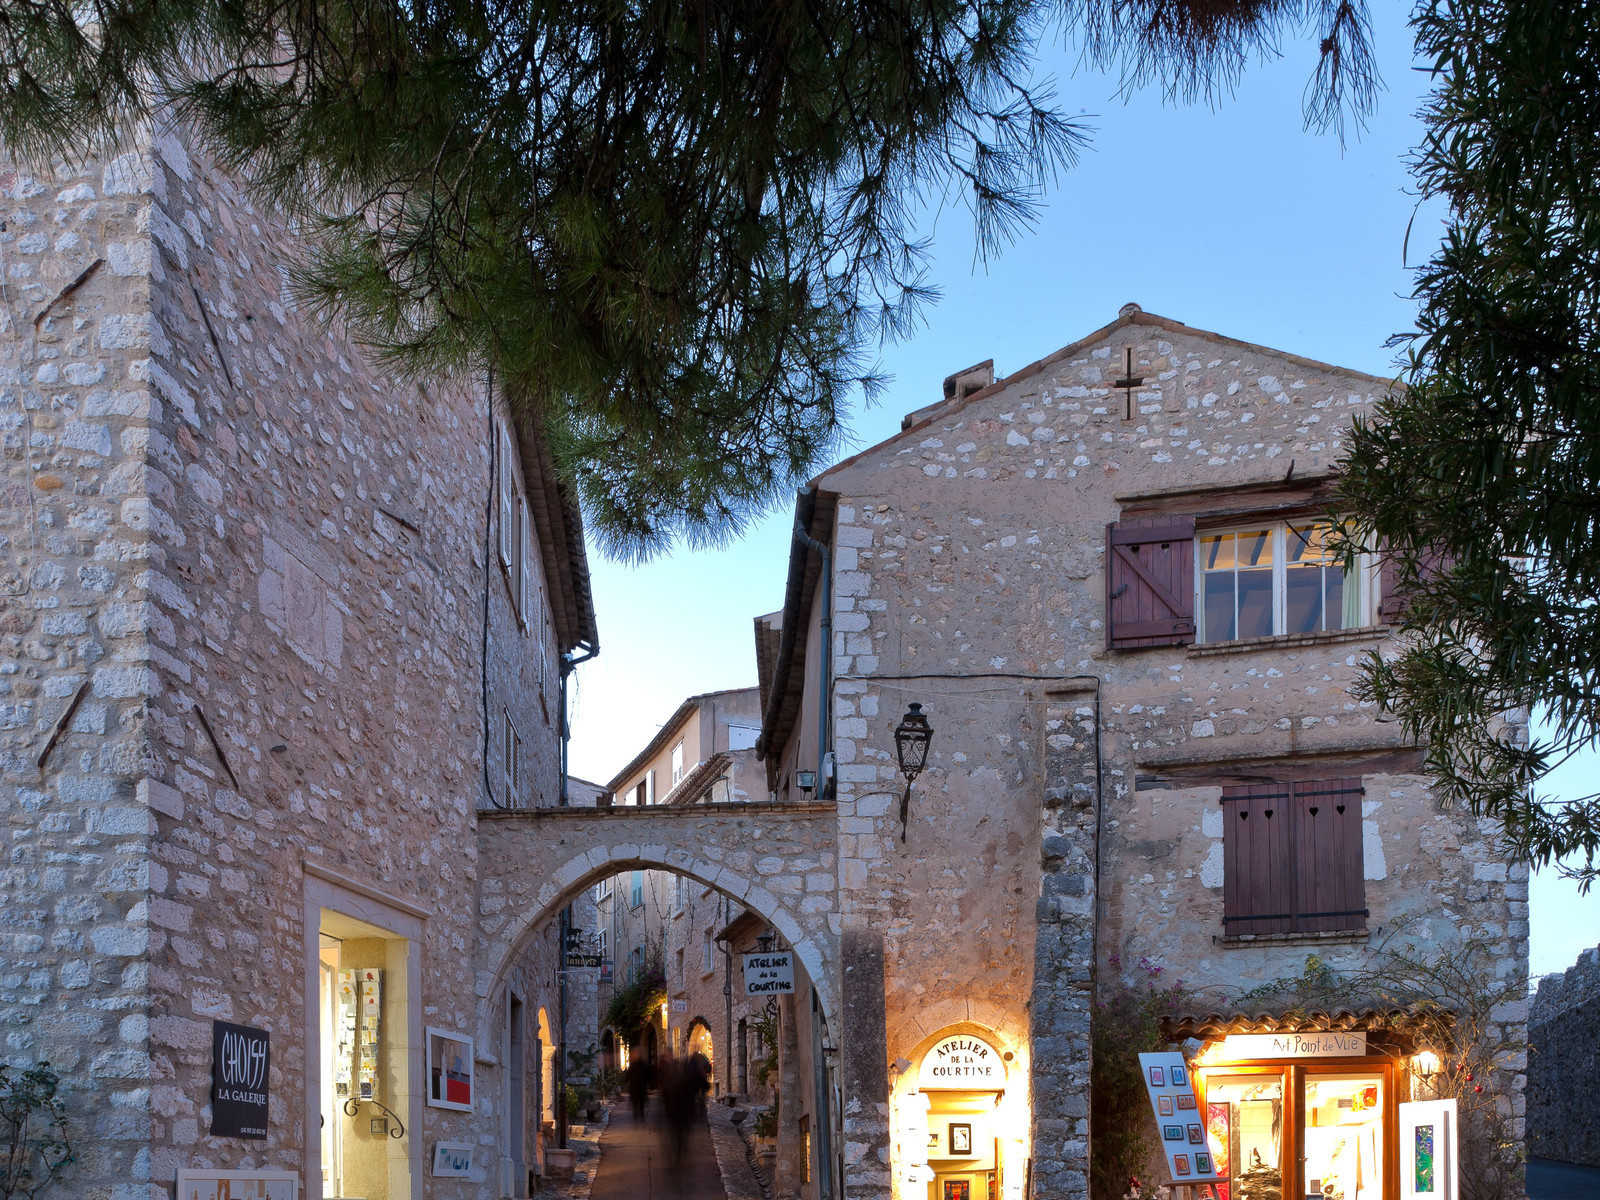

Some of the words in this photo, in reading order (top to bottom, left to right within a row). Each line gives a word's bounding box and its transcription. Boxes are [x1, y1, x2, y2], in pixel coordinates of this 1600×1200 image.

[937, 1040, 988, 1059] ATELIER
[1294, 1035, 1321, 1053] Point
[1322, 1037, 1334, 1051] de
[1334, 1035, 1359, 1051] Vue
[222, 1031, 267, 1090] CHOISY
[933, 1066, 992, 1076] COURTINE
[218, 1088, 230, 1100] LA
[232, 1090, 266, 1106] GALERIE
